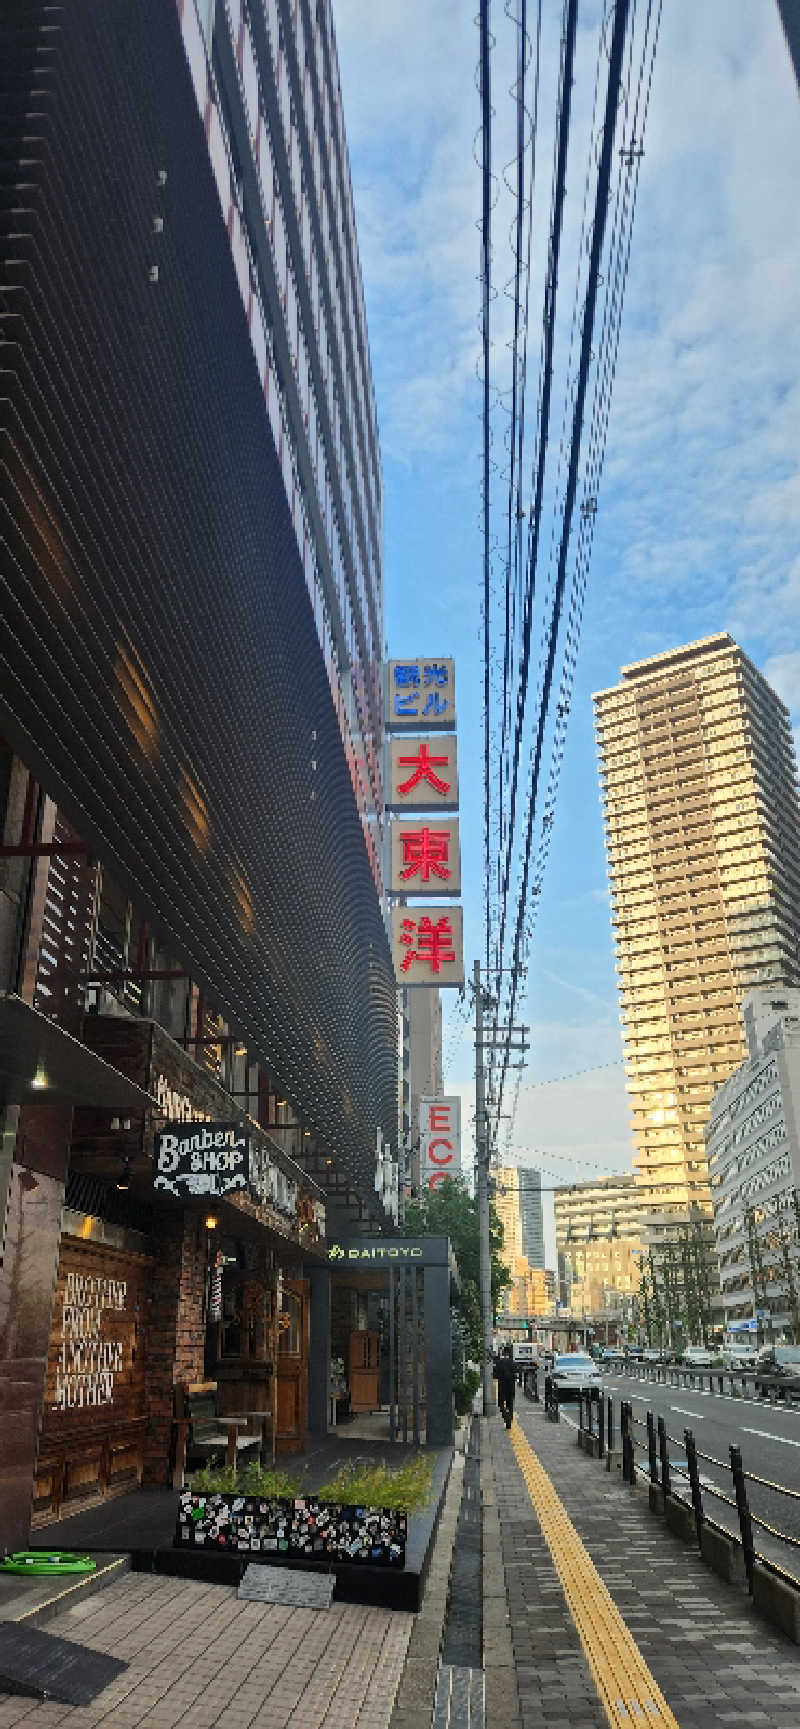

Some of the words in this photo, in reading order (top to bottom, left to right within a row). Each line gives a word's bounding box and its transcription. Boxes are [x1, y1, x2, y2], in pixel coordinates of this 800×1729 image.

[393, 691, 448, 716] ビル
[190, 1150, 244, 1172] SHOP
[348, 1247, 423, 1259] DAITOYO
